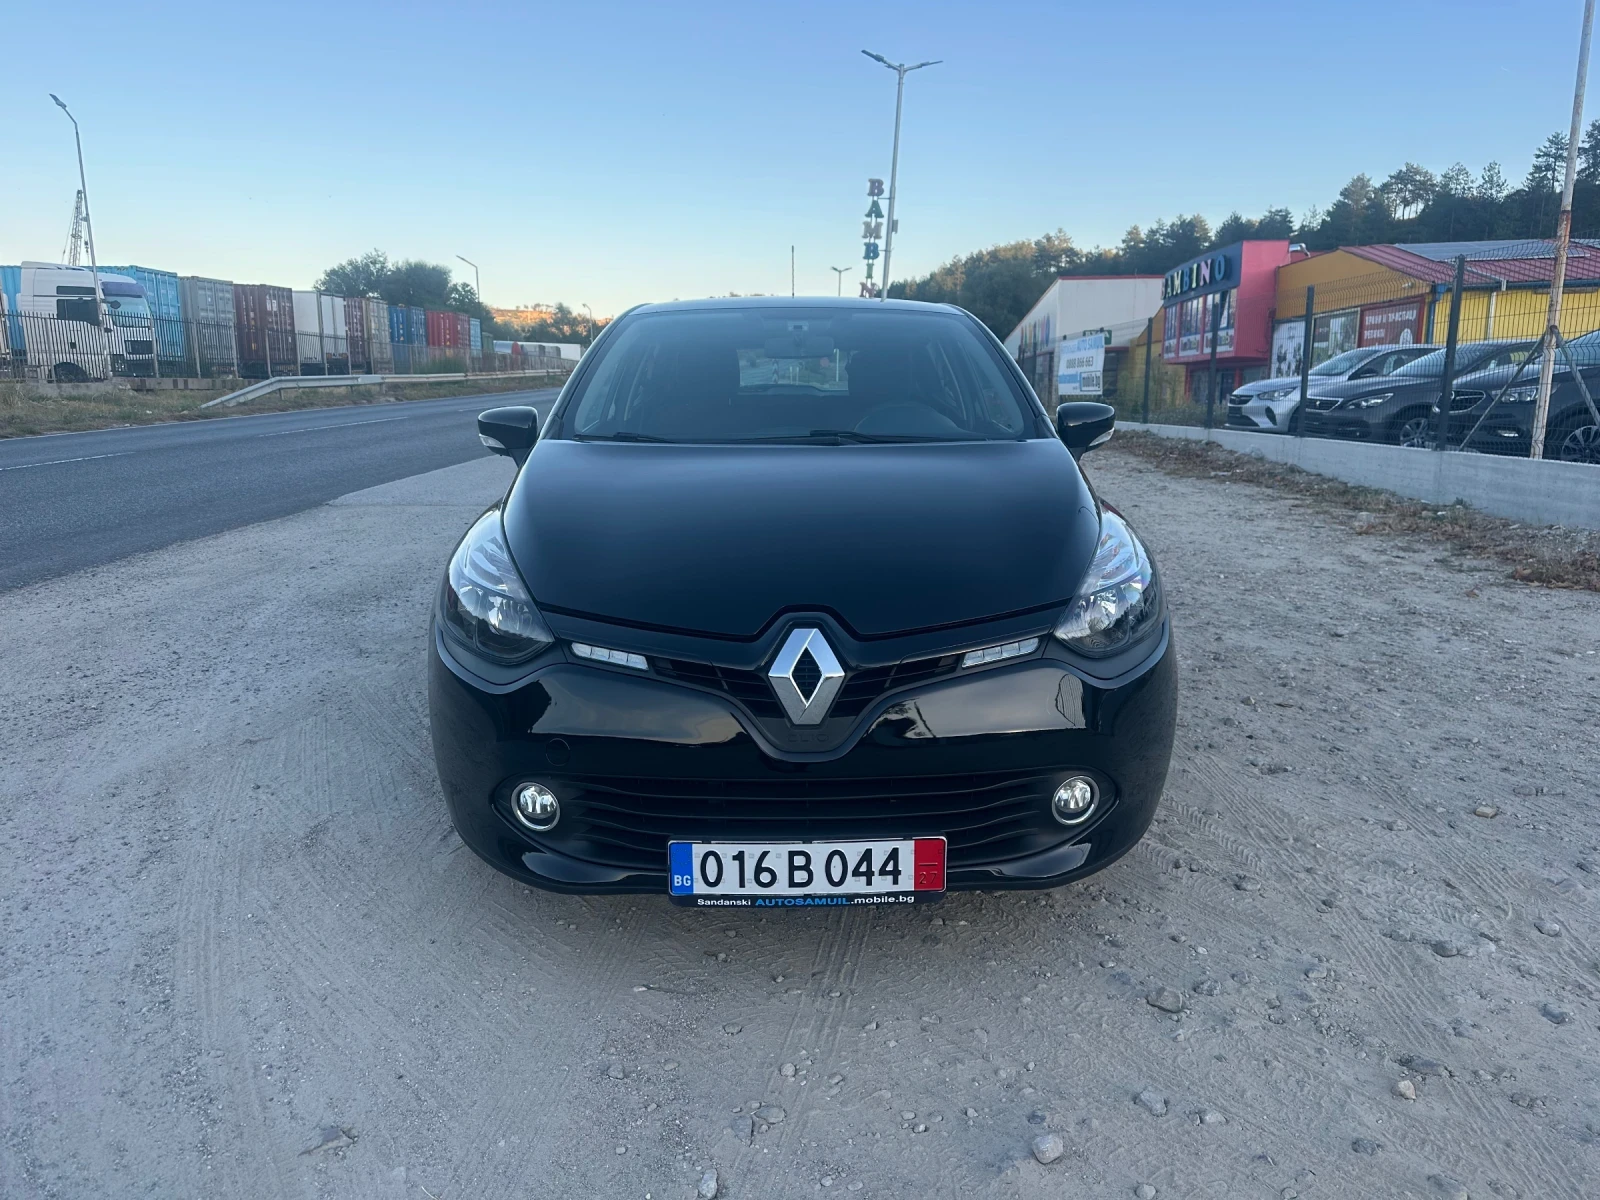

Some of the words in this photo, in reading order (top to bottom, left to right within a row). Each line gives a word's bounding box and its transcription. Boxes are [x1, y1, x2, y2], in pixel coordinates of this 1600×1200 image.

[787, 733, 829, 743] CLIO
[674, 875, 692, 886] BG
[919, 871, 939, 884] 27
[697, 898, 751, 906] Sandanski
